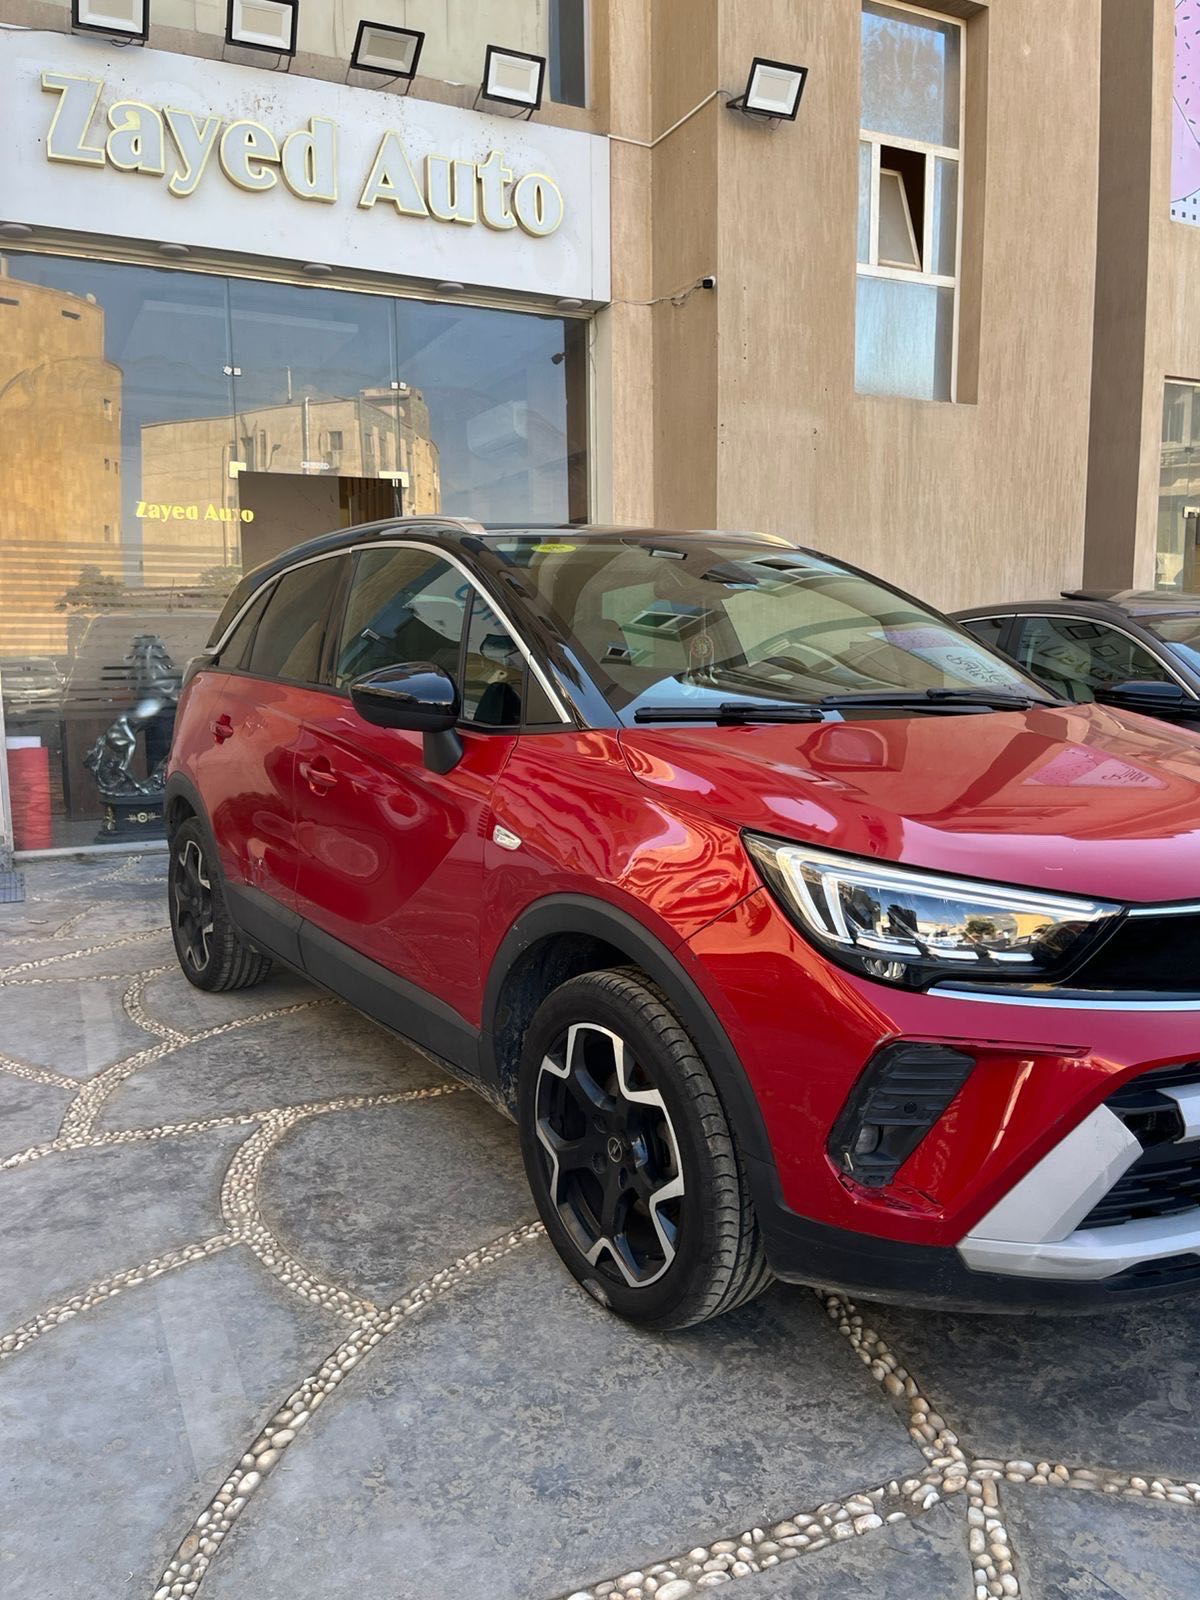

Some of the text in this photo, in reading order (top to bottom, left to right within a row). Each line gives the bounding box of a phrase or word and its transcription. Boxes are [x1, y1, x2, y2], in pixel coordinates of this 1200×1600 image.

[41, 72, 564, 236] Zayed Auto
[136, 501, 199, 522] Zayed
